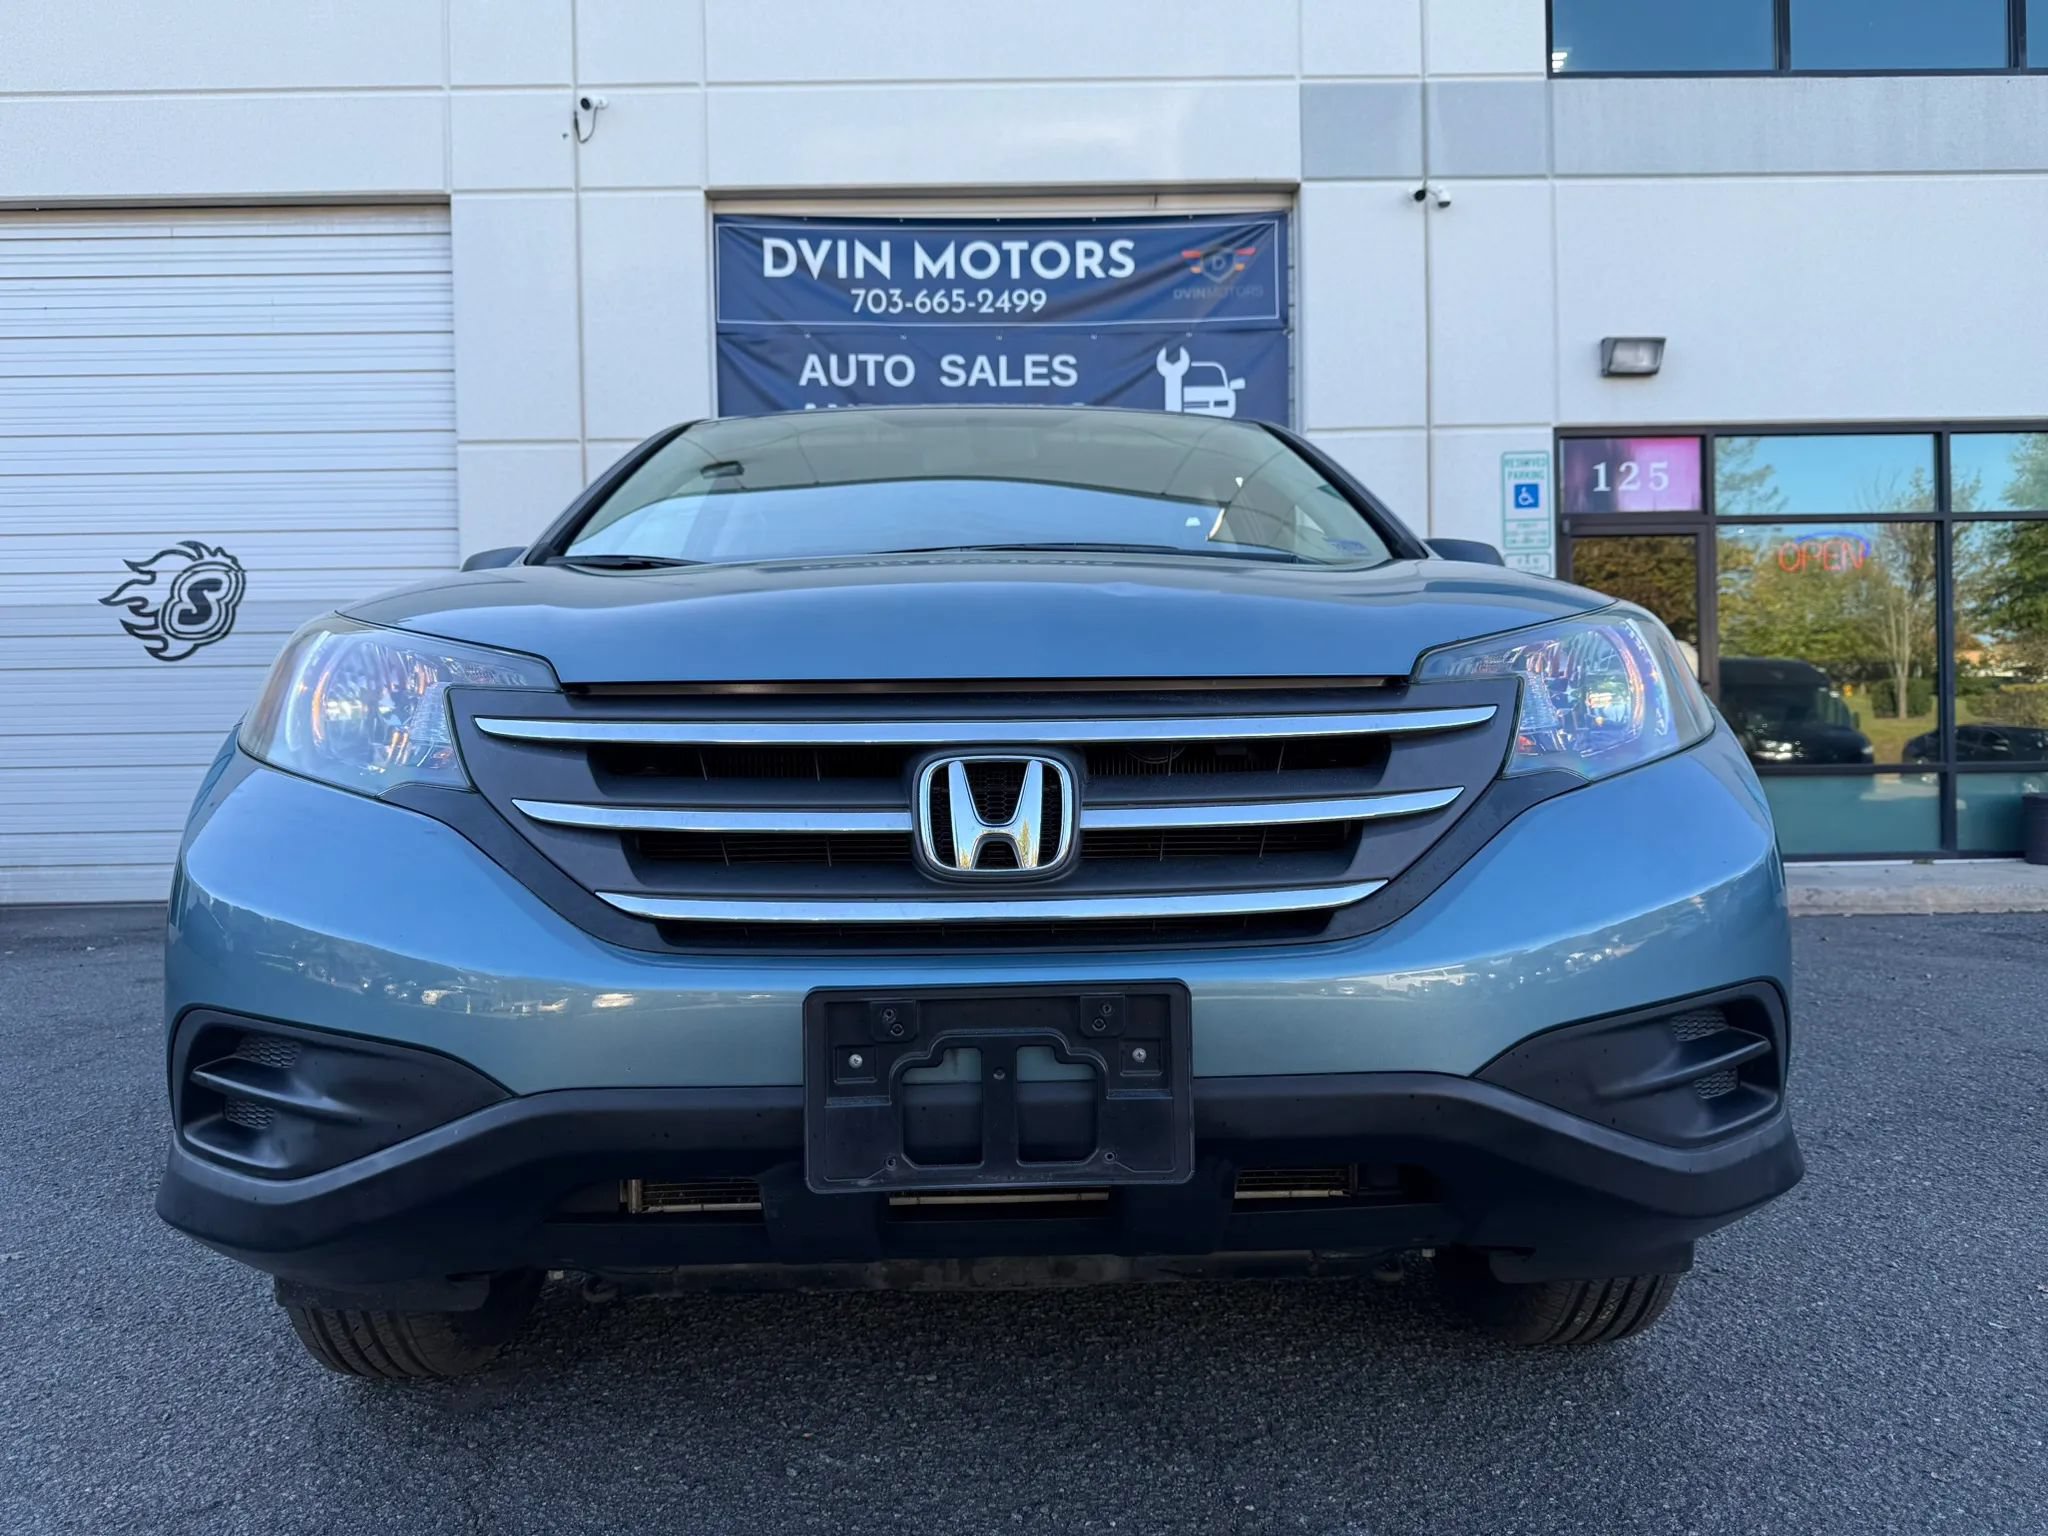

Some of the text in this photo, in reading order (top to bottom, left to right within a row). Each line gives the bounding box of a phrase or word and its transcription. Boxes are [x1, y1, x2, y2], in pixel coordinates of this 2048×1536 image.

[762, 238, 1136, 280] DVIN MOTORS
[851, 288, 1047, 314] 703-665-2499
[799, 354, 1079, 387] AUTO SALES
[1592, 461, 1669, 492] 125
[1778, 541, 1866, 572] OPEN
